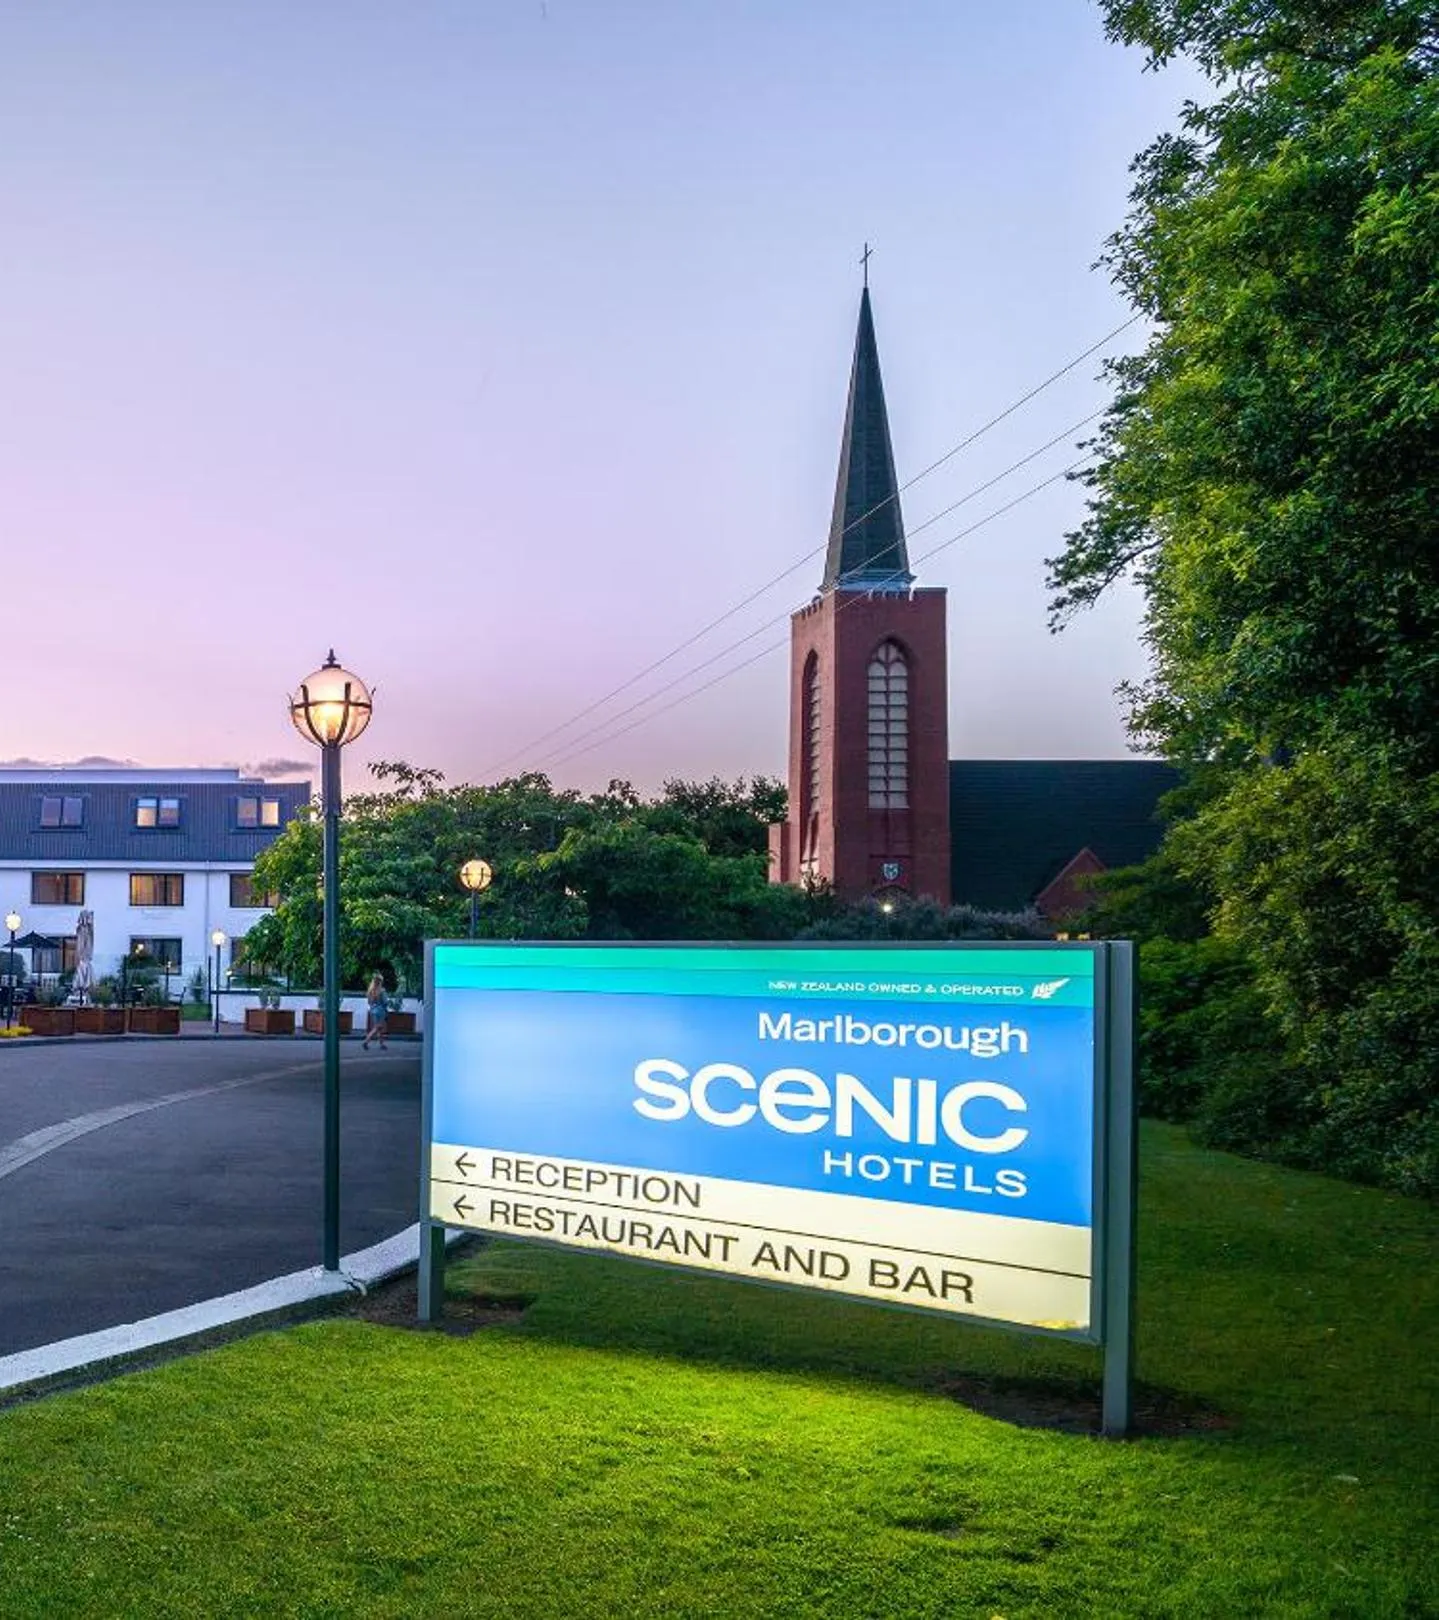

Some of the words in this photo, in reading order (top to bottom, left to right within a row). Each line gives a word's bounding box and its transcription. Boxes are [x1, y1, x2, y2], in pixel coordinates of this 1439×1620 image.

[768, 981, 797, 991] NEW
[801, 982, 865, 992] ZEALAND
[868, 982, 921, 994] OWNED
[925, 984, 936, 994] &
[940, 984, 1024, 996] OPERATED
[758, 1012, 1028, 1058] Marlborough
[491, 1156, 701, 1208] RECEPTION
[823, 1150, 1028, 1198] HOTELS
[490, 1199, 739, 1262] RESTAURANT
[752, 1241, 850, 1281] AND
[868, 1258, 974, 1304] BAR
